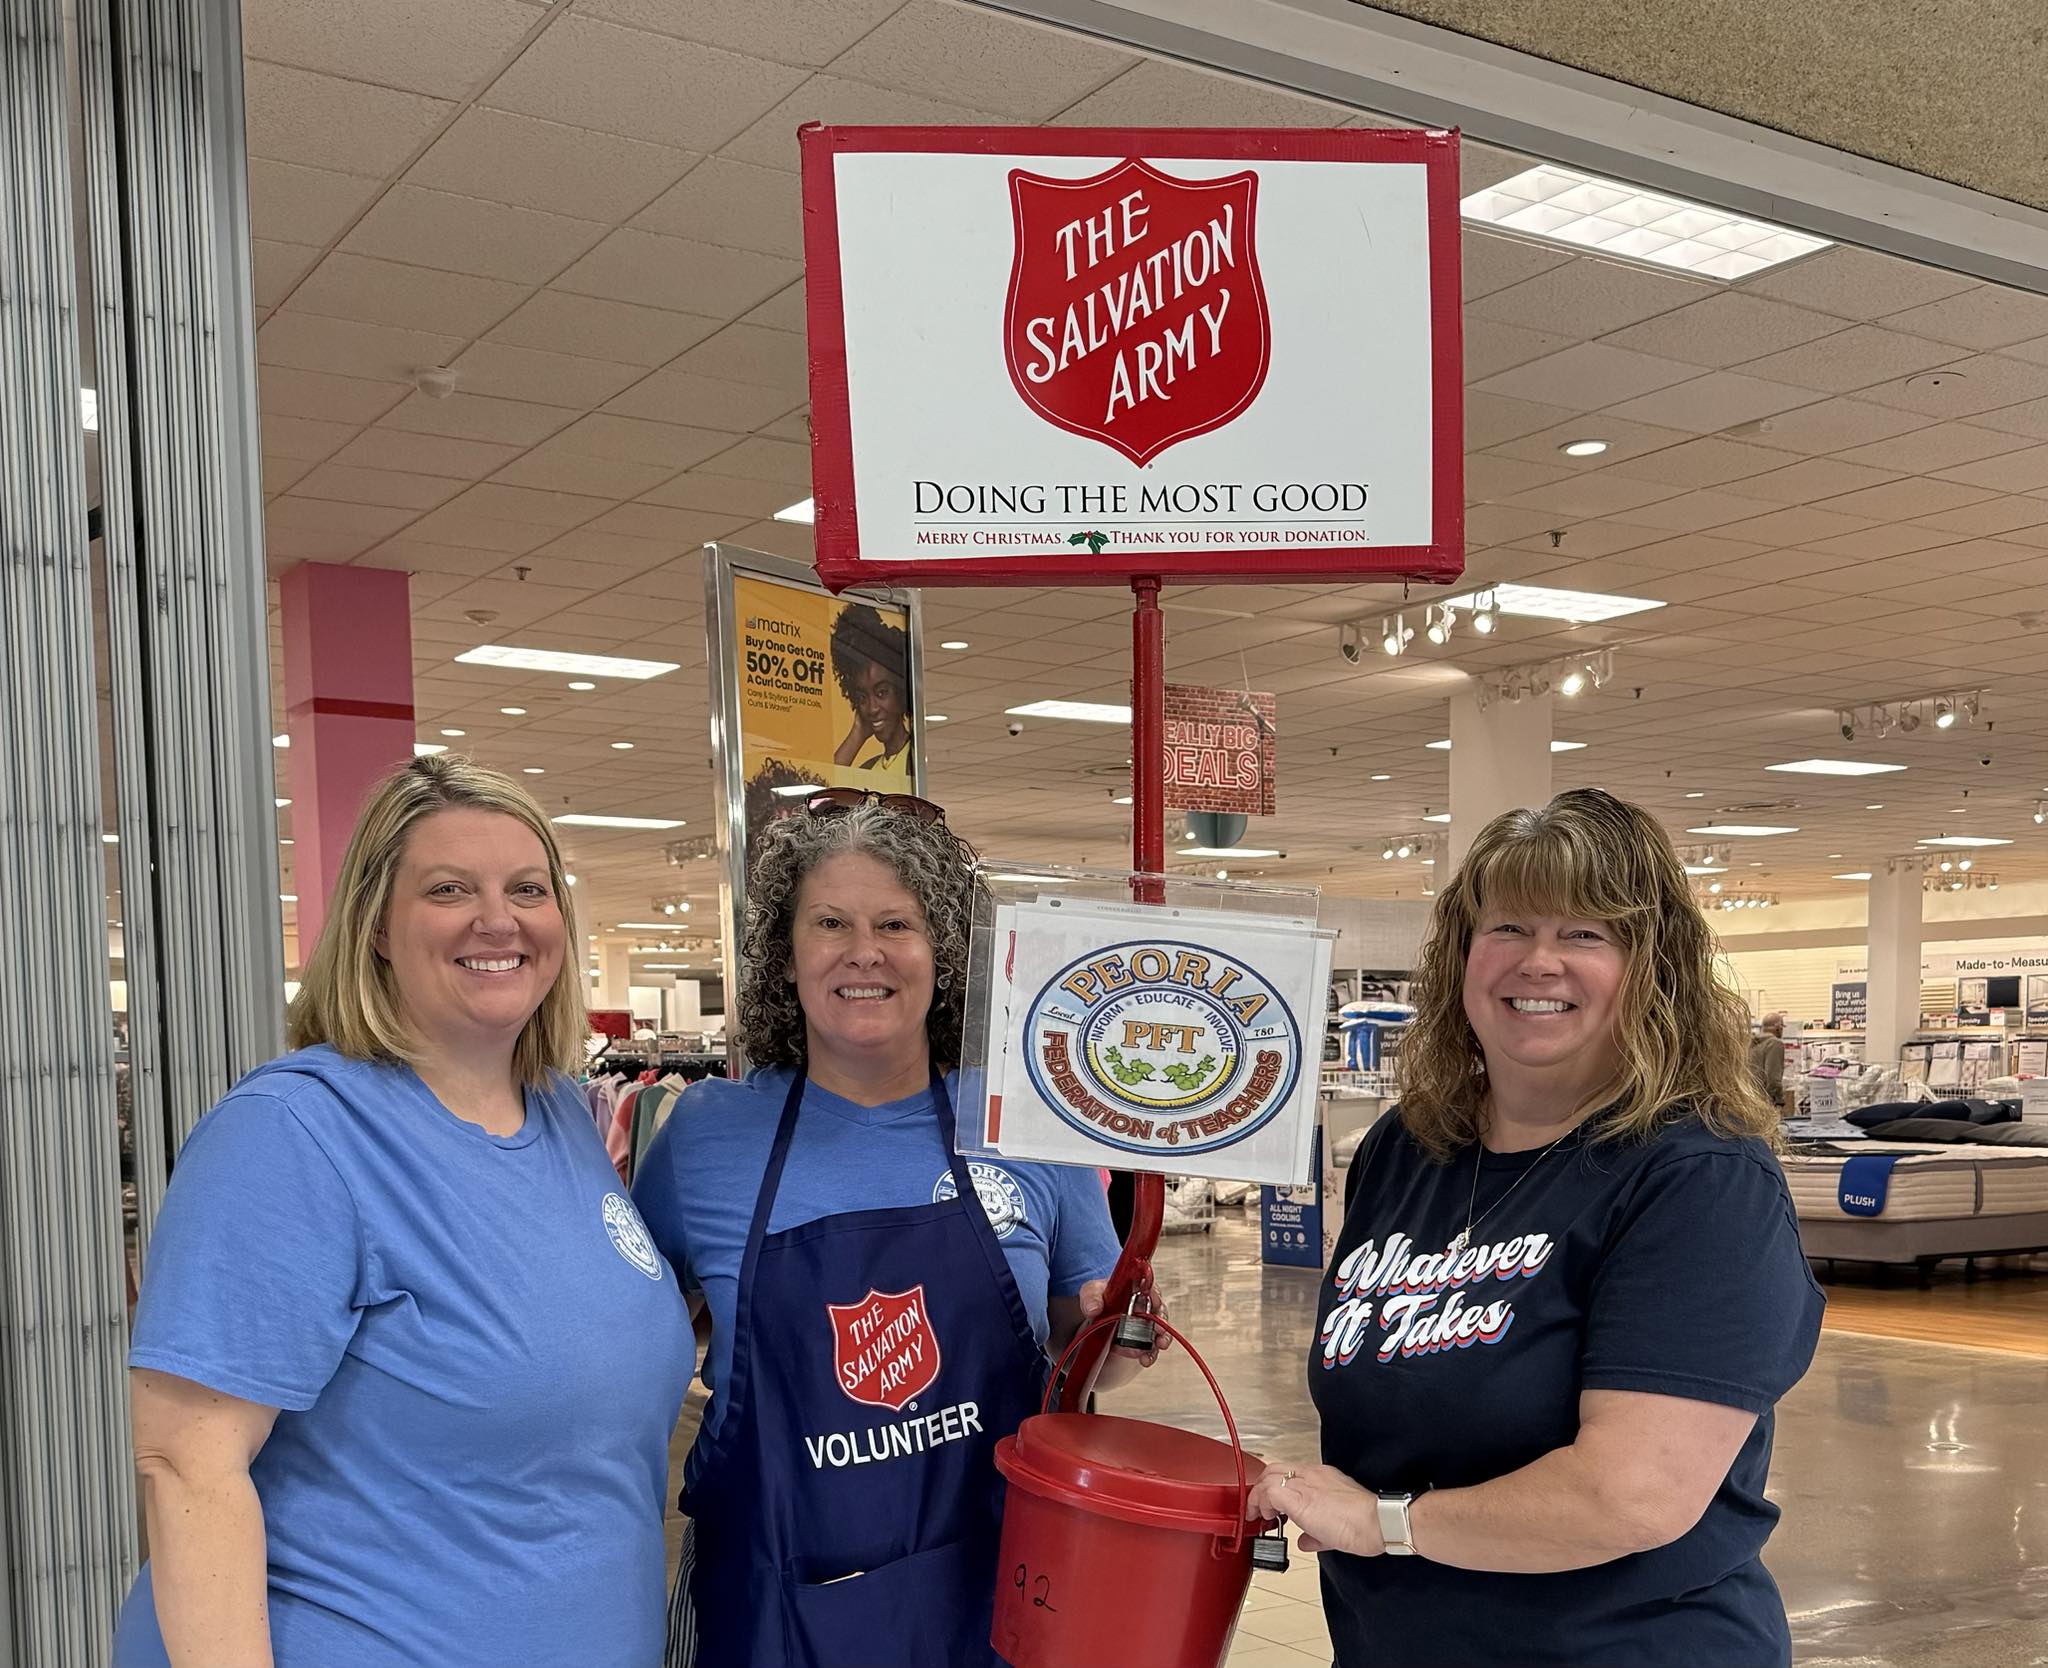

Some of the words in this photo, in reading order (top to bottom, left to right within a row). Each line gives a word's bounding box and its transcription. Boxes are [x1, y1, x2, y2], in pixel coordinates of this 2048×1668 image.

[1055, 189, 1150, 282] THE
[1026, 203, 1235, 383] SALVATION
[1104, 288, 1230, 425] ARMY
[913, 480, 1046, 514] DOING
[1055, 485, 1128, 513] THE
[1139, 484, 1242, 512] MOST
[916, 531, 968, 544] MERRY
[973, 531, 1065, 544] CHRISTMAS.
[1110, 530, 1165, 544] THANK
[1169, 531, 1200, 543] YOU
[1205, 531, 1235, 543] FOR
[1239, 531, 1280, 543] YOUR
[1285, 530, 1370, 542] DONATION.
[757, 617, 801, 638] matrix
[745, 635, 764, 650] Buy
[765, 639, 785, 652] One
[787, 644, 804, 656] Get
[806, 648, 824, 660] One
[746, 651, 789, 678] 50%
[793, 659, 824, 684] Off
[747, 674, 754, 684] A
[755, 675, 774, 687] Curl
[775, 680, 793, 690] Can
[795, 683, 823, 696] Dream
[1223, 725, 1258, 750] BIG
[1060, 948, 1269, 1027] PEORIA
[1835, 990, 1851, 999] Bring
[1047, 1006, 1075, 1021] Local
[1091, 1003, 1125, 1042] INFORM
[1135, 993, 1196, 1010] EDUCATE
[1204, 1011, 1234, 1053] INVOLVE
[1121, 1020, 1204, 1053] PFT
[1254, 1026, 1274, 1038] 780
[1043, 1030, 1154, 1140] FEDERATION
[1156, 1122, 1180, 1145] of
[1180, 1050, 1282, 1140] TEACHERS
[1269, 1204, 1282, 1213] ALL
[1282, 1205, 1302, 1214] NIGHT
[1271, 1213, 1301, 1222] COOLING
[1844, 1193, 1876, 1208] PLUSH
[1335, 1232, 1554, 1300] Whatever
[849, 1302, 884, 1346] THE
[1320, 1298, 1372, 1370] It
[1376, 1290, 1515, 1363] Takes
[843, 1299, 921, 1389] SALVATION
[880, 1334, 923, 1400] ARMY
[805, 1401, 983, 1469] VOLUNTEER
[1014, 1563, 1057, 1612] 92
